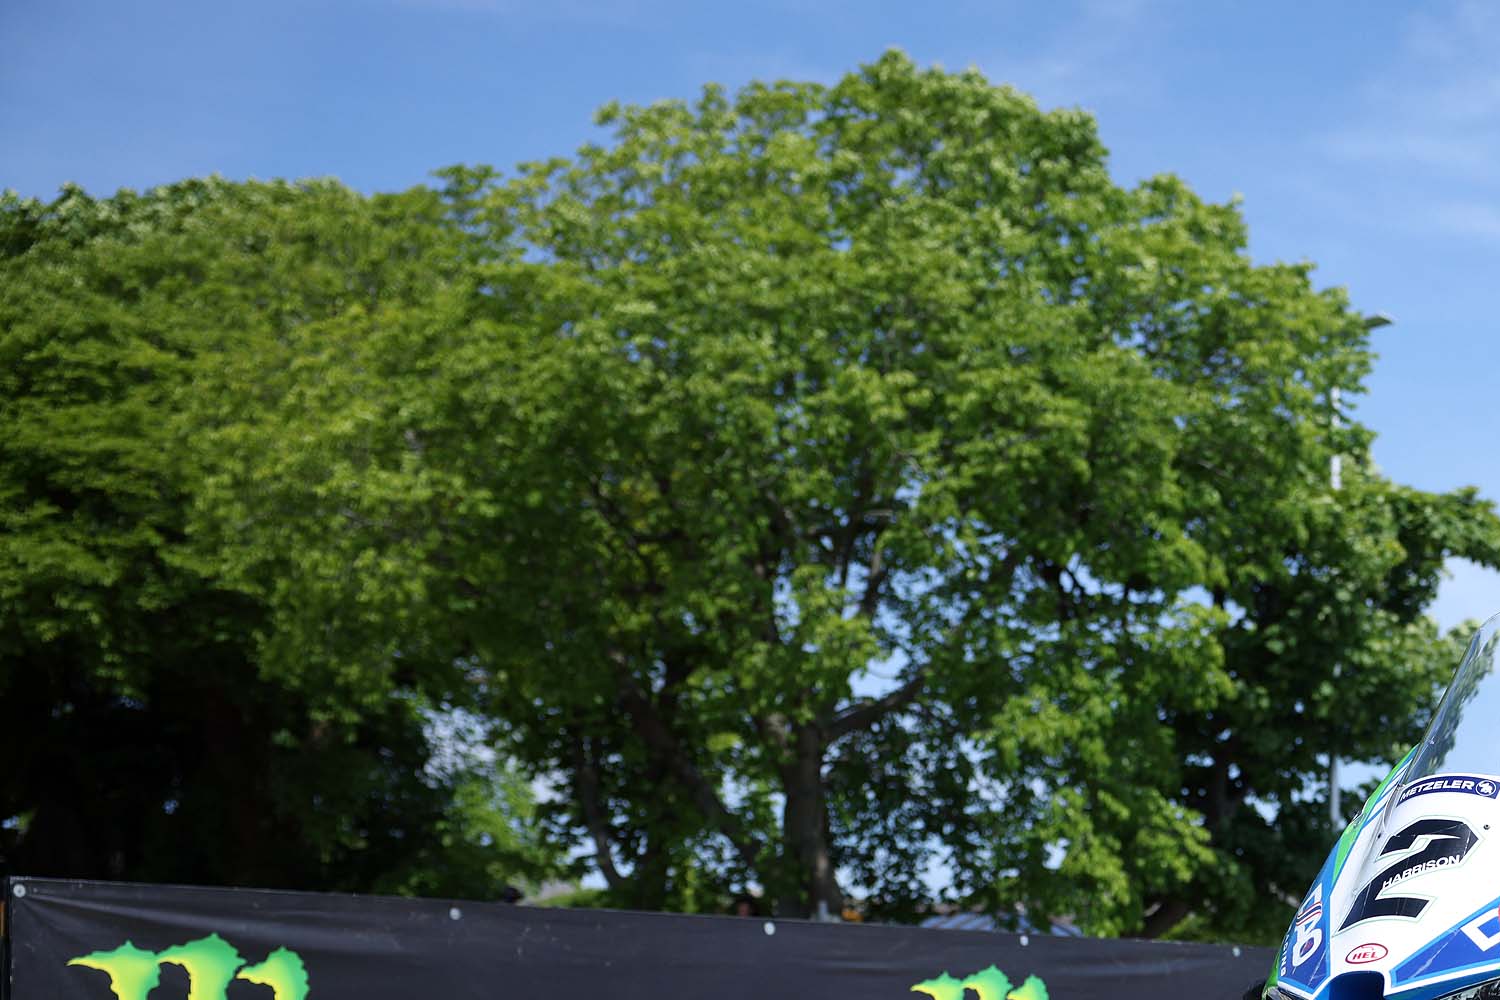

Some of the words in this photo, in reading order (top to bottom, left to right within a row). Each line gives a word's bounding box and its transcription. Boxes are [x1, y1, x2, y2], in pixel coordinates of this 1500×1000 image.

[1401, 779, 1475, 800] METZELER
[1338, 818, 1479, 932] 2
[1382, 854, 1461, 889] HARRISON
[1352, 951, 1378, 961] HEL
